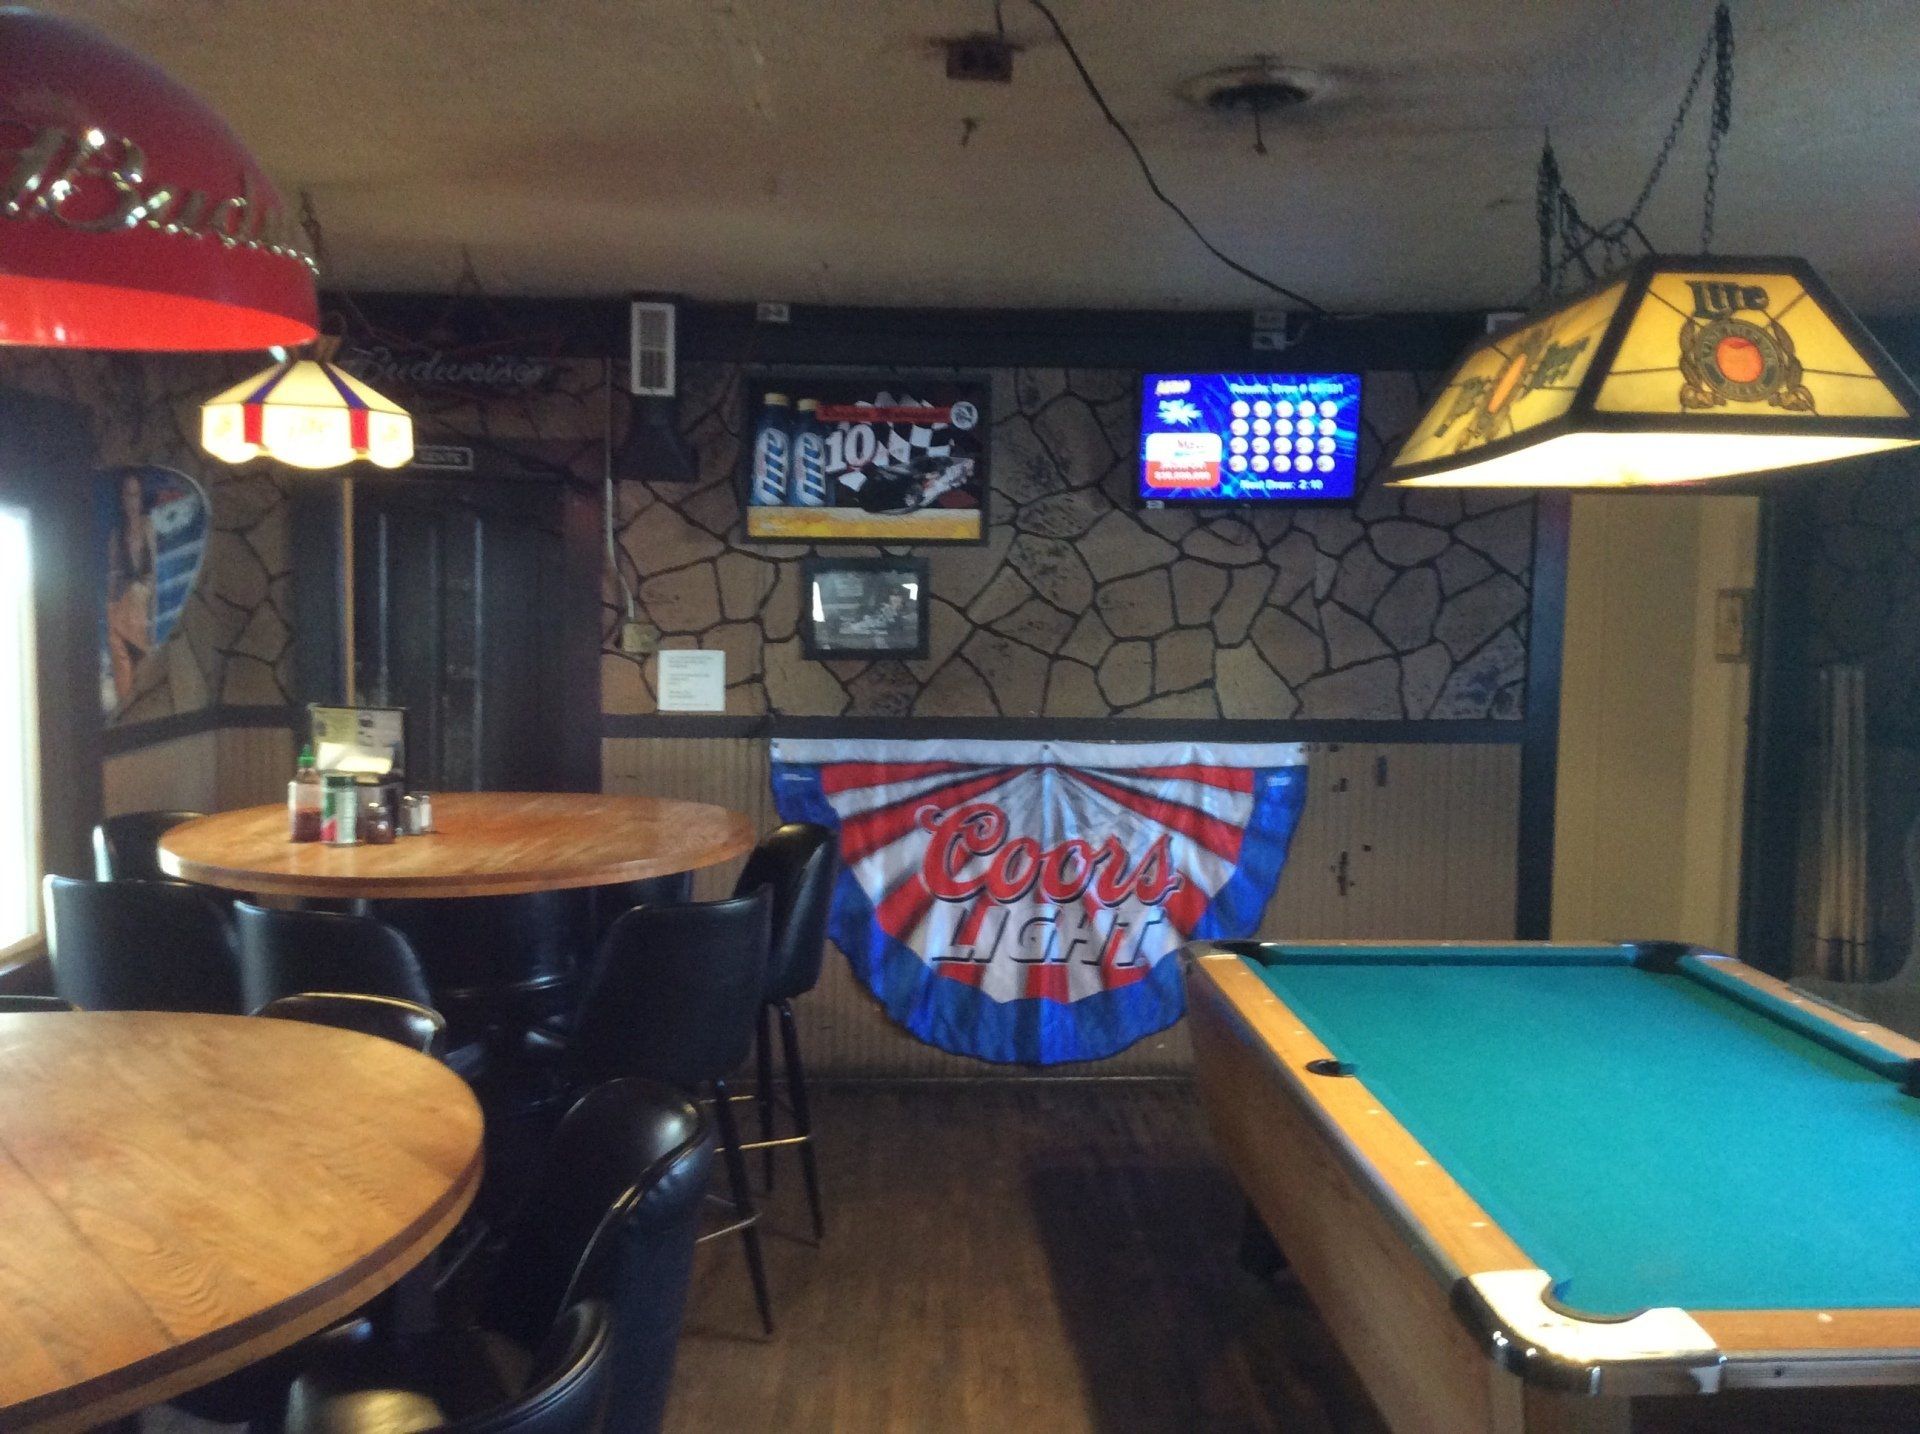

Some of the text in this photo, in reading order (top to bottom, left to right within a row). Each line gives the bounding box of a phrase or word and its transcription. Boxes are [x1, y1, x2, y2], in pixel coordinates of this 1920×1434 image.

[825, 423, 876, 474] 10
[915, 802, 1186, 910] Coors
[928, 903, 1166, 967] LIGHT
